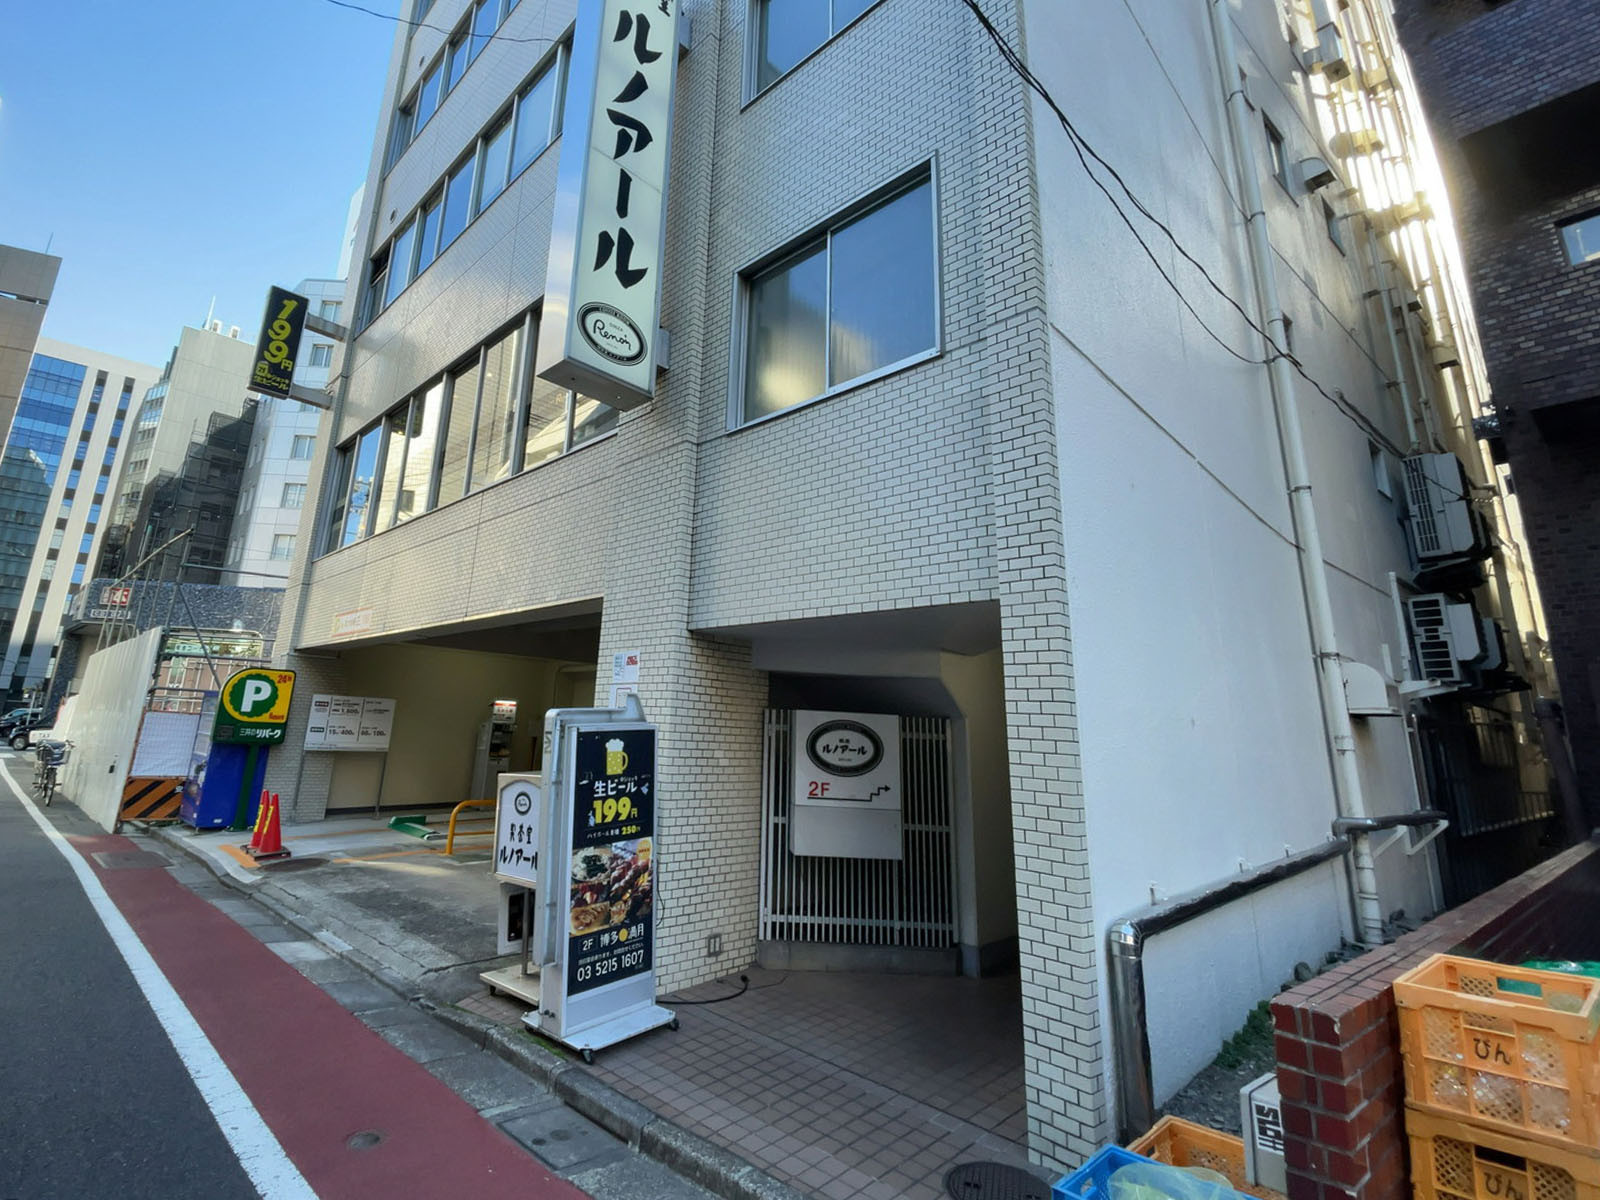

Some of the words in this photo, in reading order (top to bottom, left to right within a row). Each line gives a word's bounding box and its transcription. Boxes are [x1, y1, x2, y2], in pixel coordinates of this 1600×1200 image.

[593, 10, 662, 289] ルノアール
[593, 319, 631, 351] Renoir
[240, 679, 272, 713] P
[822, 744, 868, 756] ルノアール
[593, 779, 638, 797] 生ビール
[808, 780, 830, 797] 2F
[500, 846, 538, 871] ルノアール
[582, 938, 594, 951] 2F
[577, 965, 592, 981] 03
[595, 957, 618, 977] 5215
[621, 949, 645, 969] 1607
[1473, 1037, 1511, 1065] びん
[1484, 1172, 1523, 1200] びん
